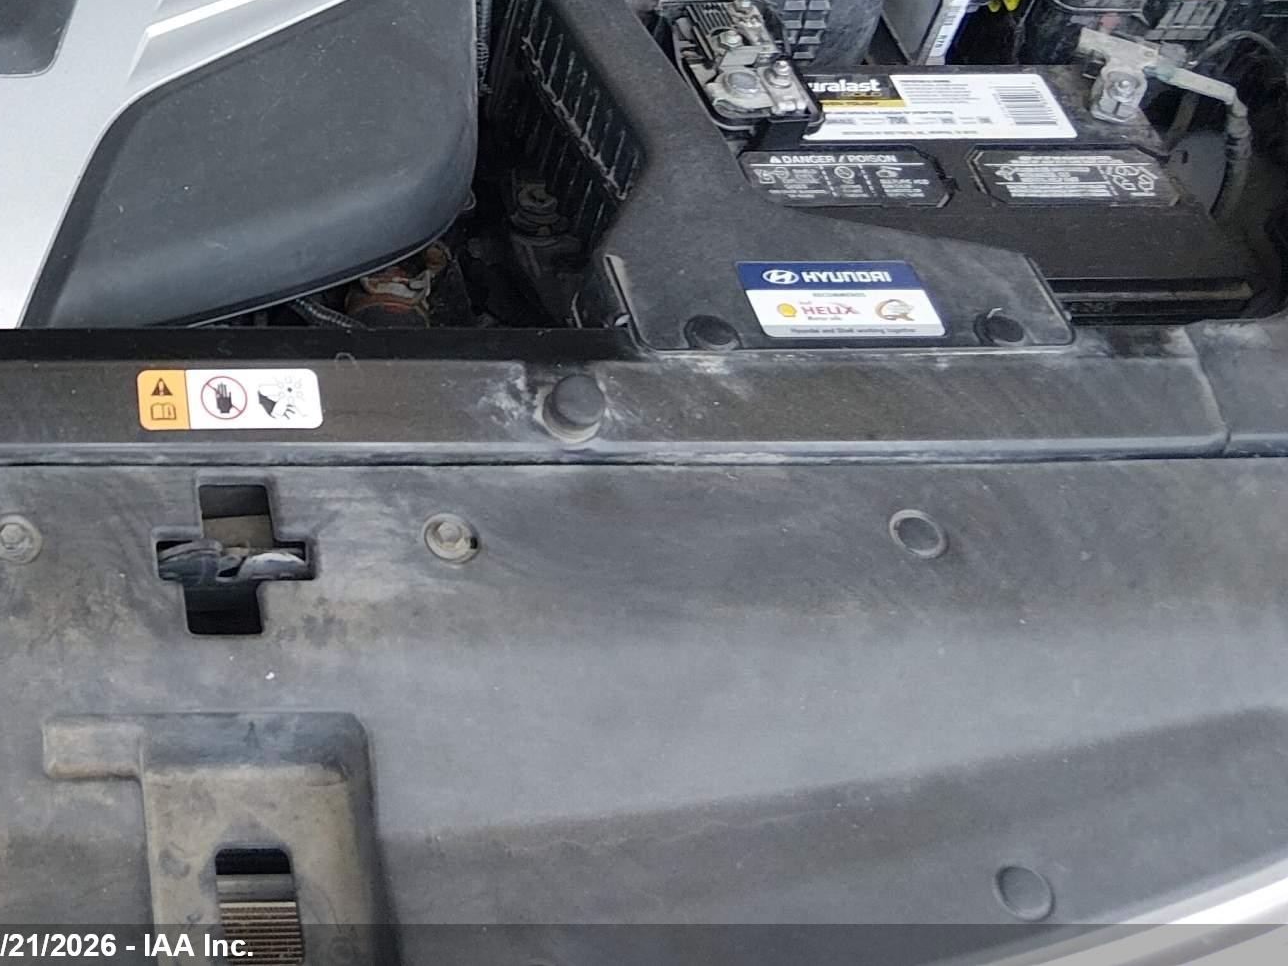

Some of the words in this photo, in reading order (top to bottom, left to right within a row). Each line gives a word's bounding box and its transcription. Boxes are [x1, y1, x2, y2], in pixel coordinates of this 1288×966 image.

[781, 155, 836, 163] DANGER
[846, 155, 898, 163] POISON
[801, 272, 892, 283] HYUNDAI
[801, 306, 857, 315] HELIX
